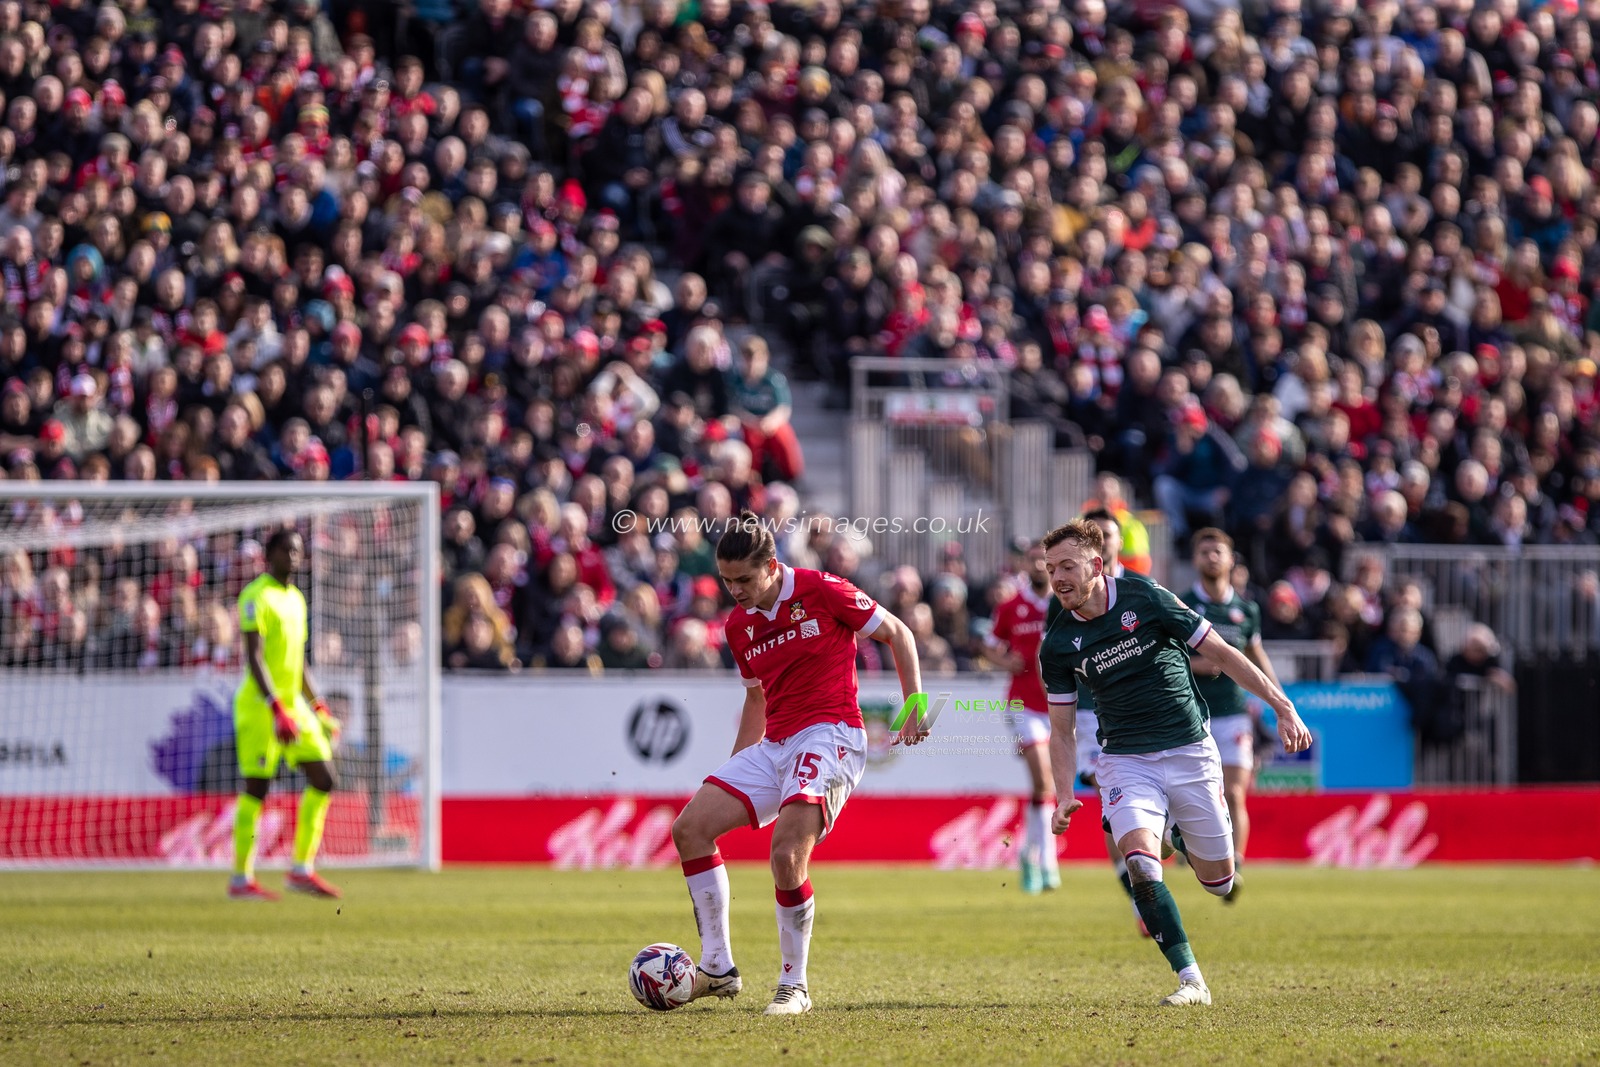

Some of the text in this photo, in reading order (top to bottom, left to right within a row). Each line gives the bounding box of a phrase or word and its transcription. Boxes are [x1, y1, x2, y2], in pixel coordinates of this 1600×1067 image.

[744, 629, 797, 661] UNITED
[1091, 637, 1139, 664] victorian
[792, 751, 823, 780] 15
